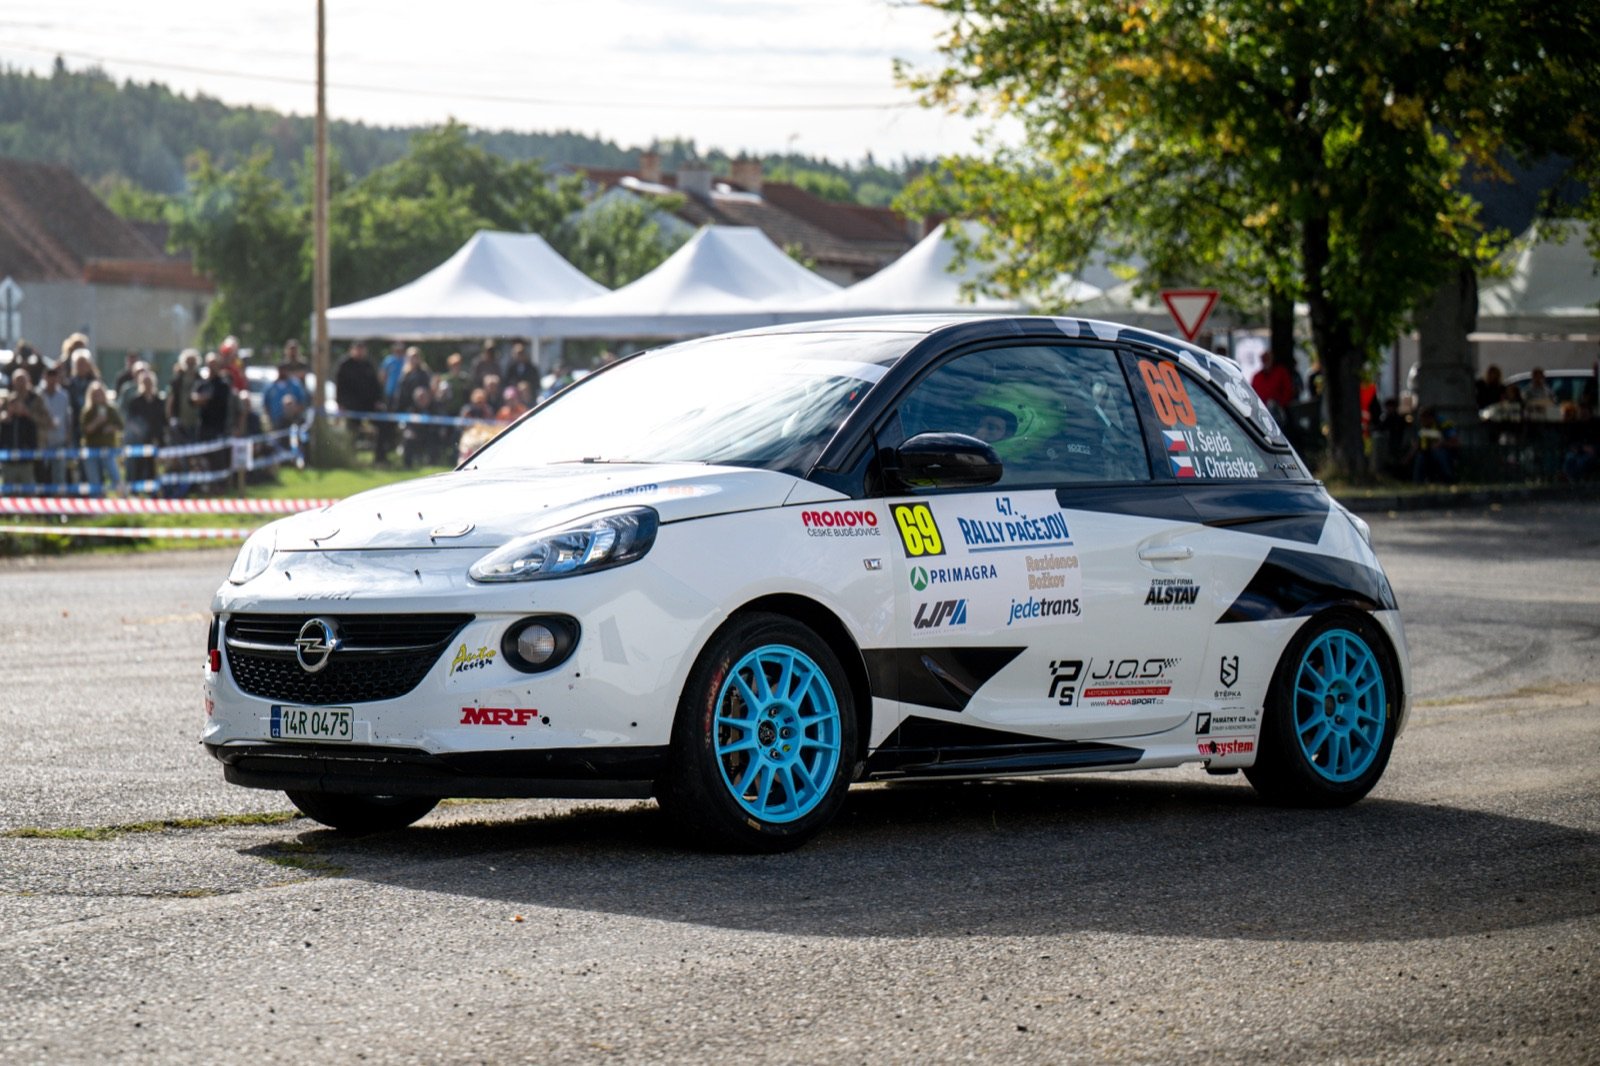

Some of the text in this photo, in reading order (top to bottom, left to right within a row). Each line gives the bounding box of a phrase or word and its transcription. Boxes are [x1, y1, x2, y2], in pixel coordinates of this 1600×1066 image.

[1138, 360, 1197, 427] 69
[1183, 426, 1232, 457] V. Šejda
[1193, 456, 1206, 478] J.
[1205, 456, 1258, 478] Chrástka
[995, 497, 1018, 516] 47.
[801, 510, 878, 527] PRONOVO
[957, 511, 1069, 545] RALLY PAČEJOV
[833, 527, 880, 537] BUDĚJOVICE
[895, 504, 943, 556] 69
[930, 564, 998, 584] PRIMAGRA
[1144, 585, 1200, 605] ALSTAV
[449, 643, 497, 677] Auto
[456, 658, 493, 673] design
[1214, 690, 1241, 698] ŠTĚPKA
[283, 710, 350, 736] 14R 0475
[460, 707, 538, 726] MRF
